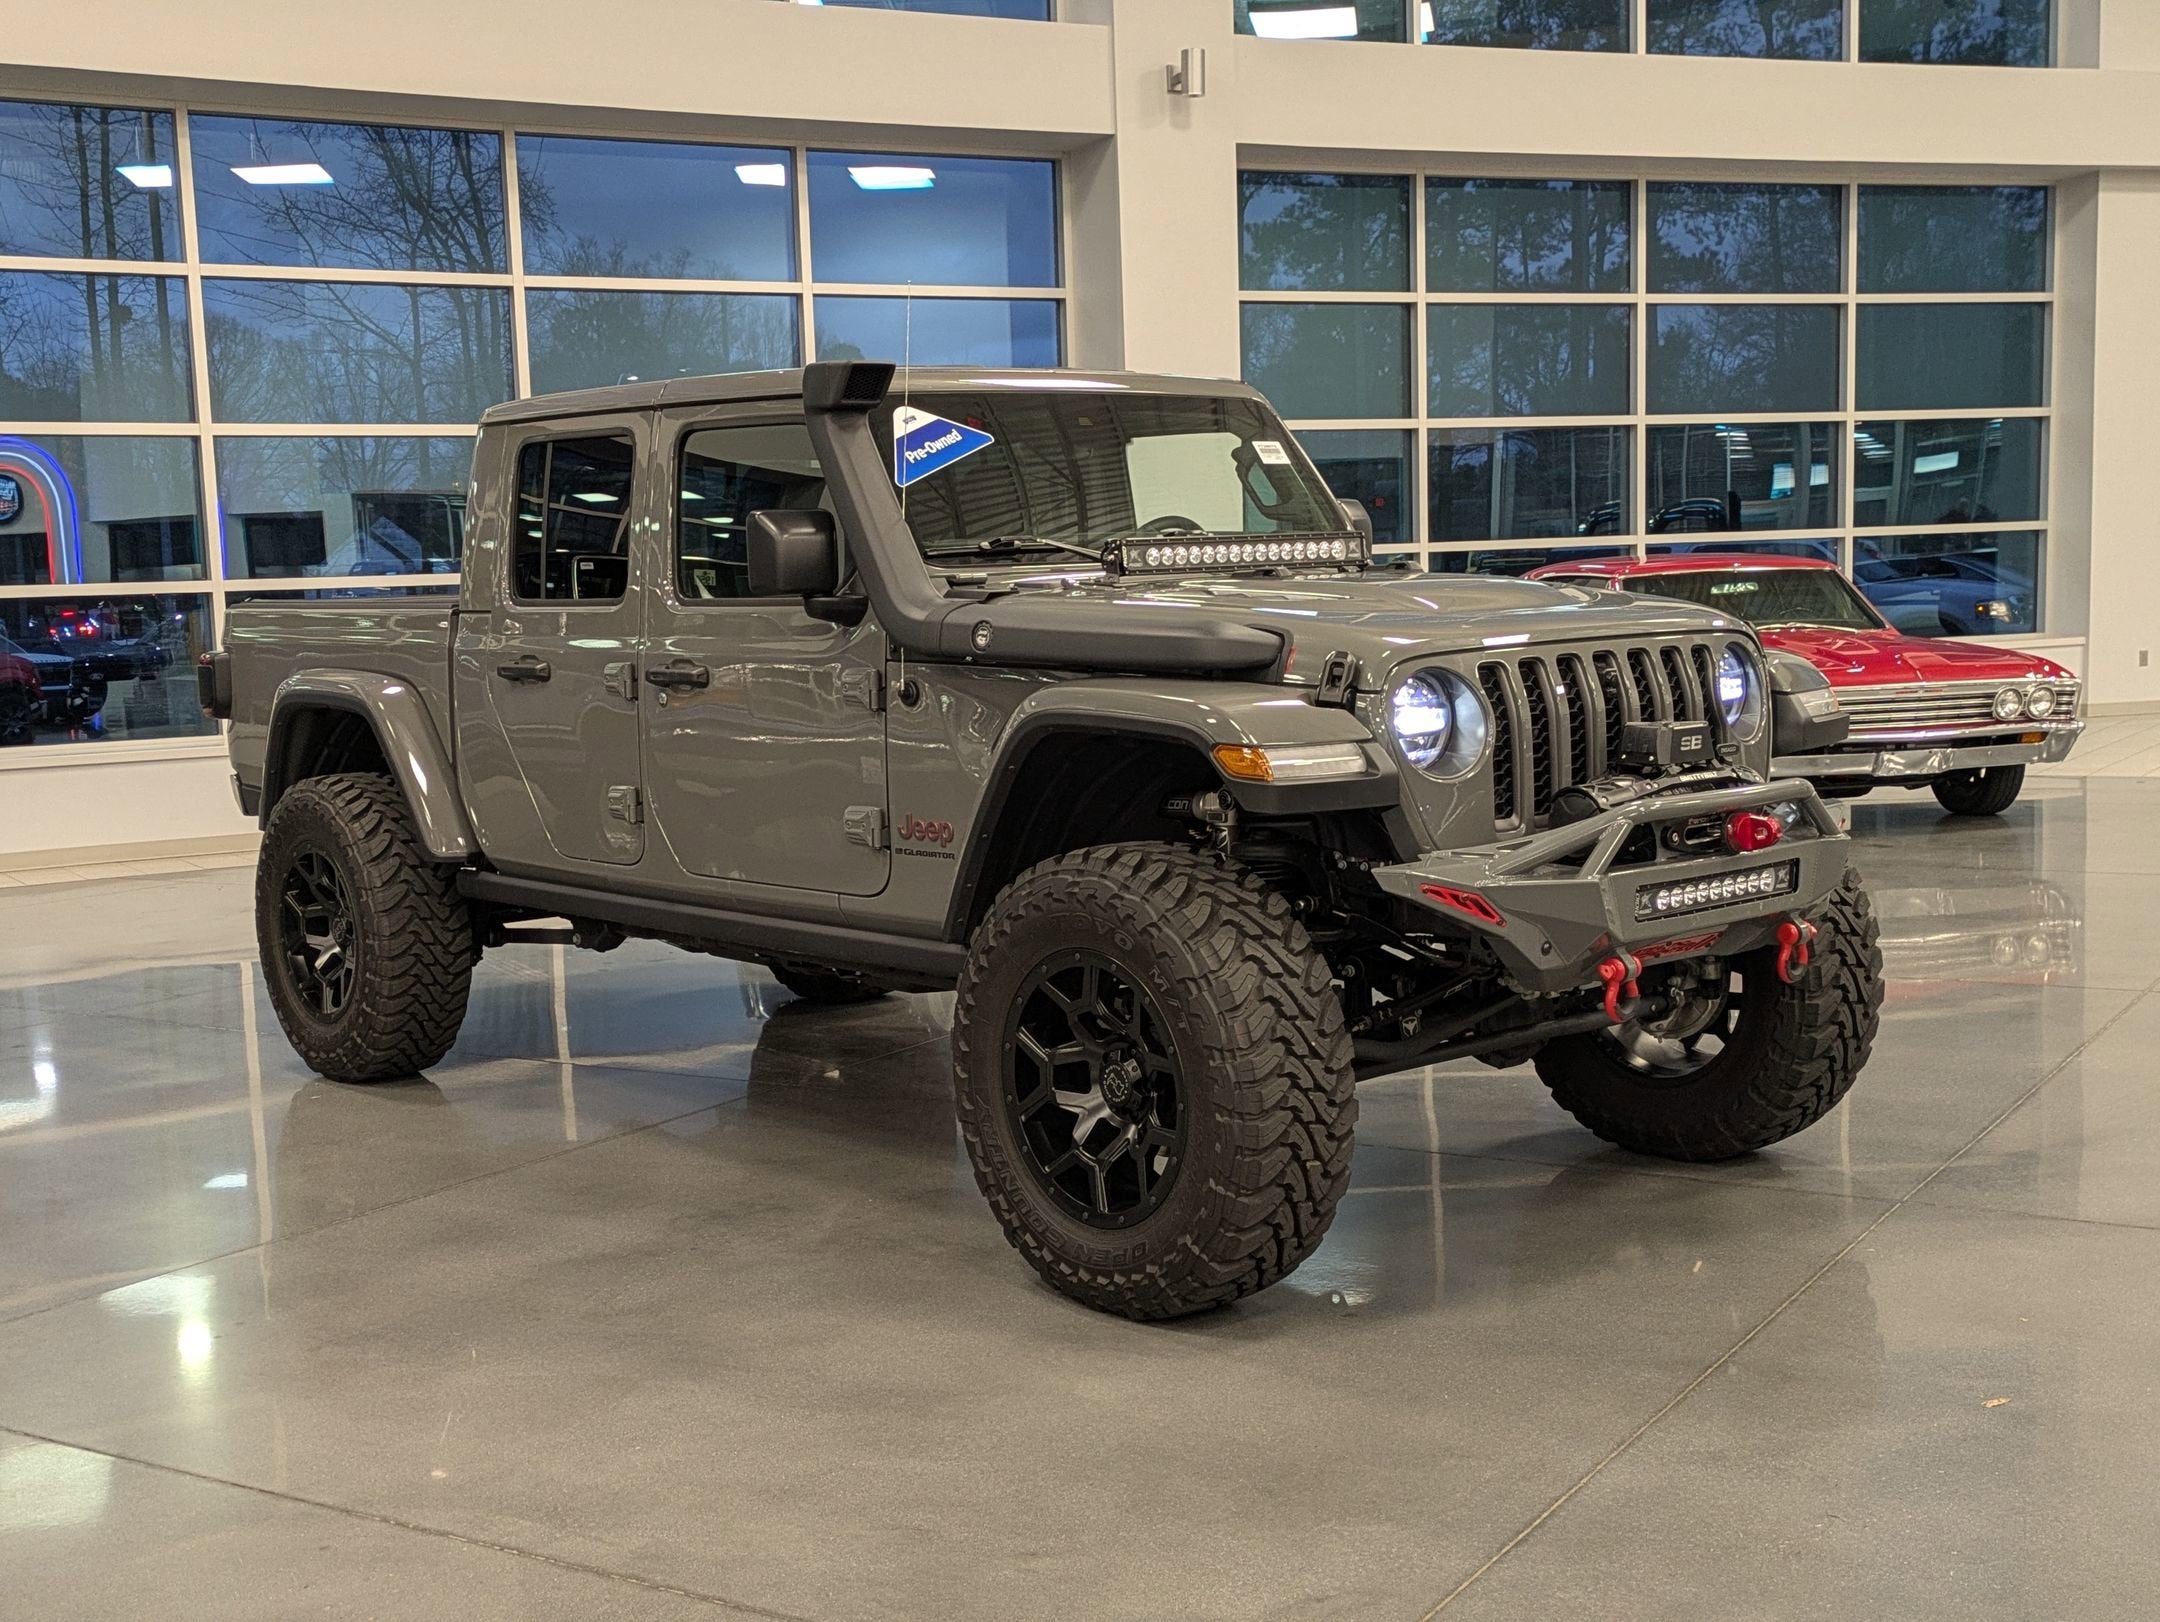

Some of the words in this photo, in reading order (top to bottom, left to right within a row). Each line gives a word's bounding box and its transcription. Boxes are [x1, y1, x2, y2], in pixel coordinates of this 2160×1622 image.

[905, 428, 963, 464] Pre-Owned
[898, 812, 954, 848] Jeep
[904, 848, 956, 860] GLADIATOR
